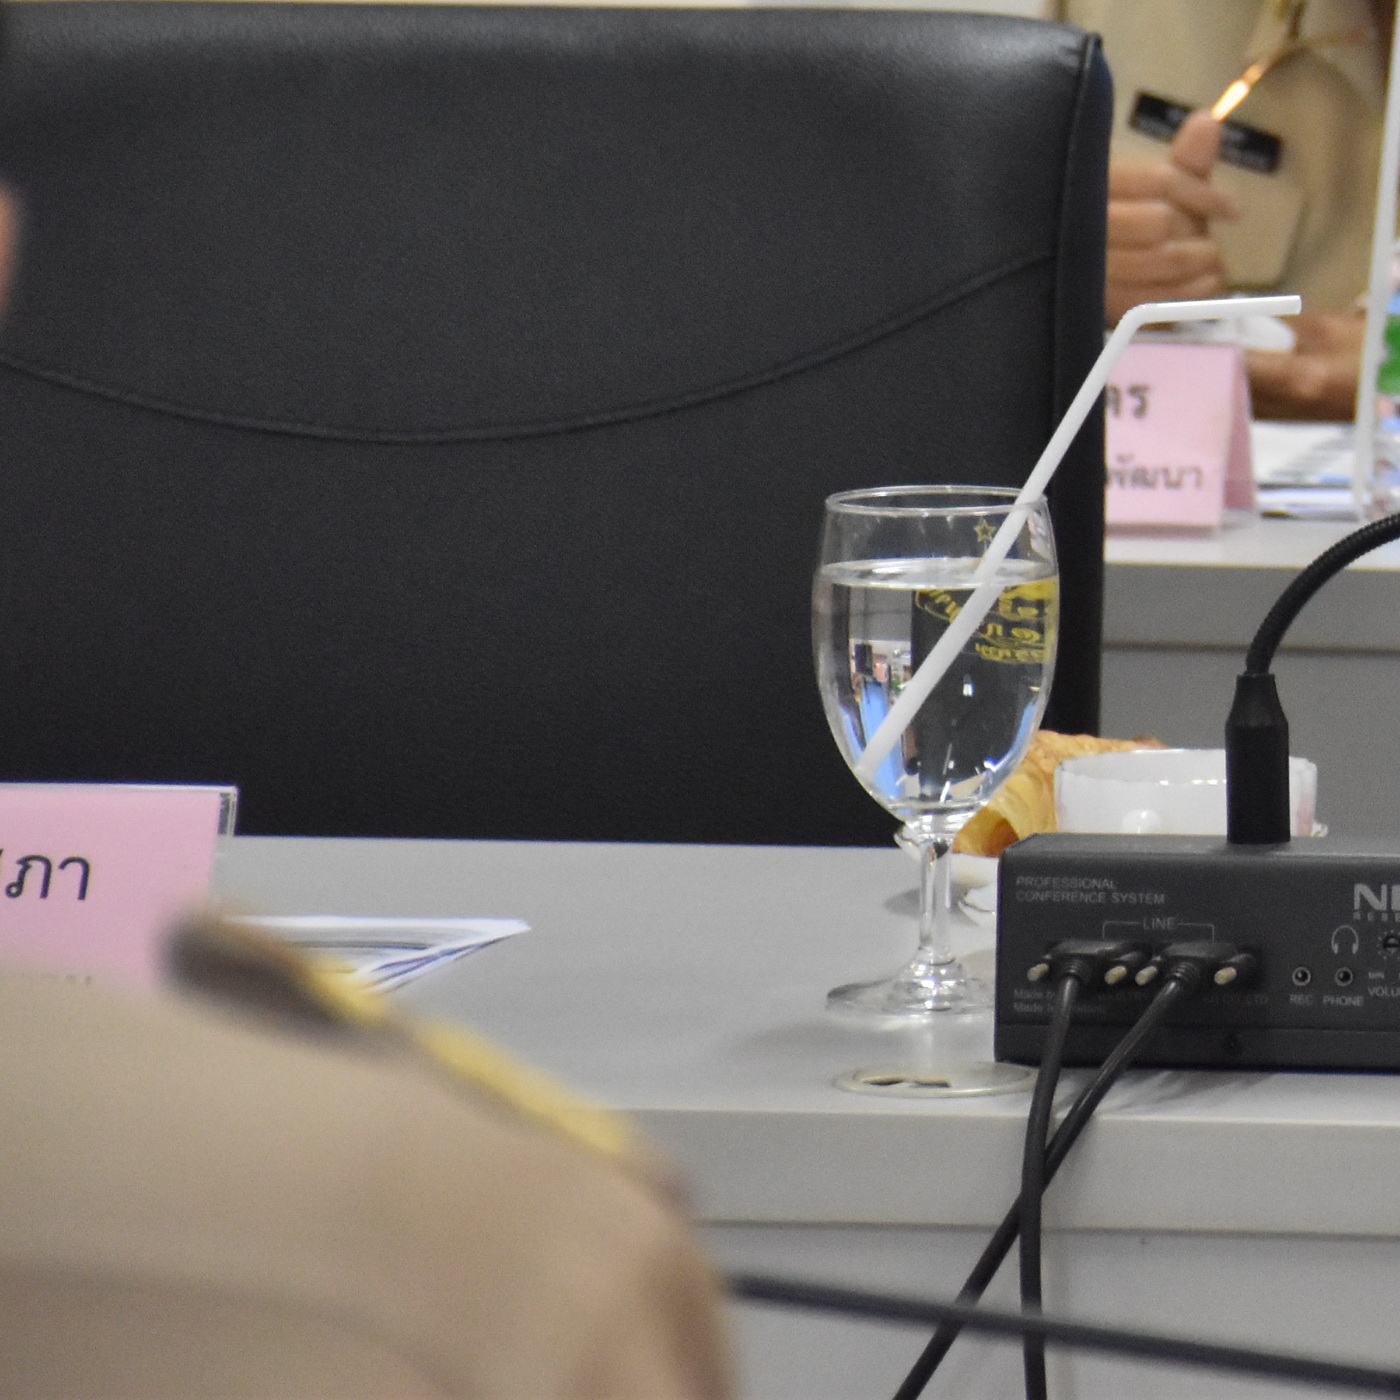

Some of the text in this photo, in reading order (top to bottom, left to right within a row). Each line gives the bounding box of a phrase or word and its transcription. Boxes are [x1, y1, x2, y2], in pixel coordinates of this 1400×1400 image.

[0, 847, 91, 902] ภา
[1015, 875, 1117, 890] PROFESSIONAL
[1015, 890, 1166, 905] CONFERENCE SYSTEM
[1143, 917, 1177, 930] LINE
[1288, 994, 1314, 1006] REC
[1322, 994, 1364, 1007] PHONE
